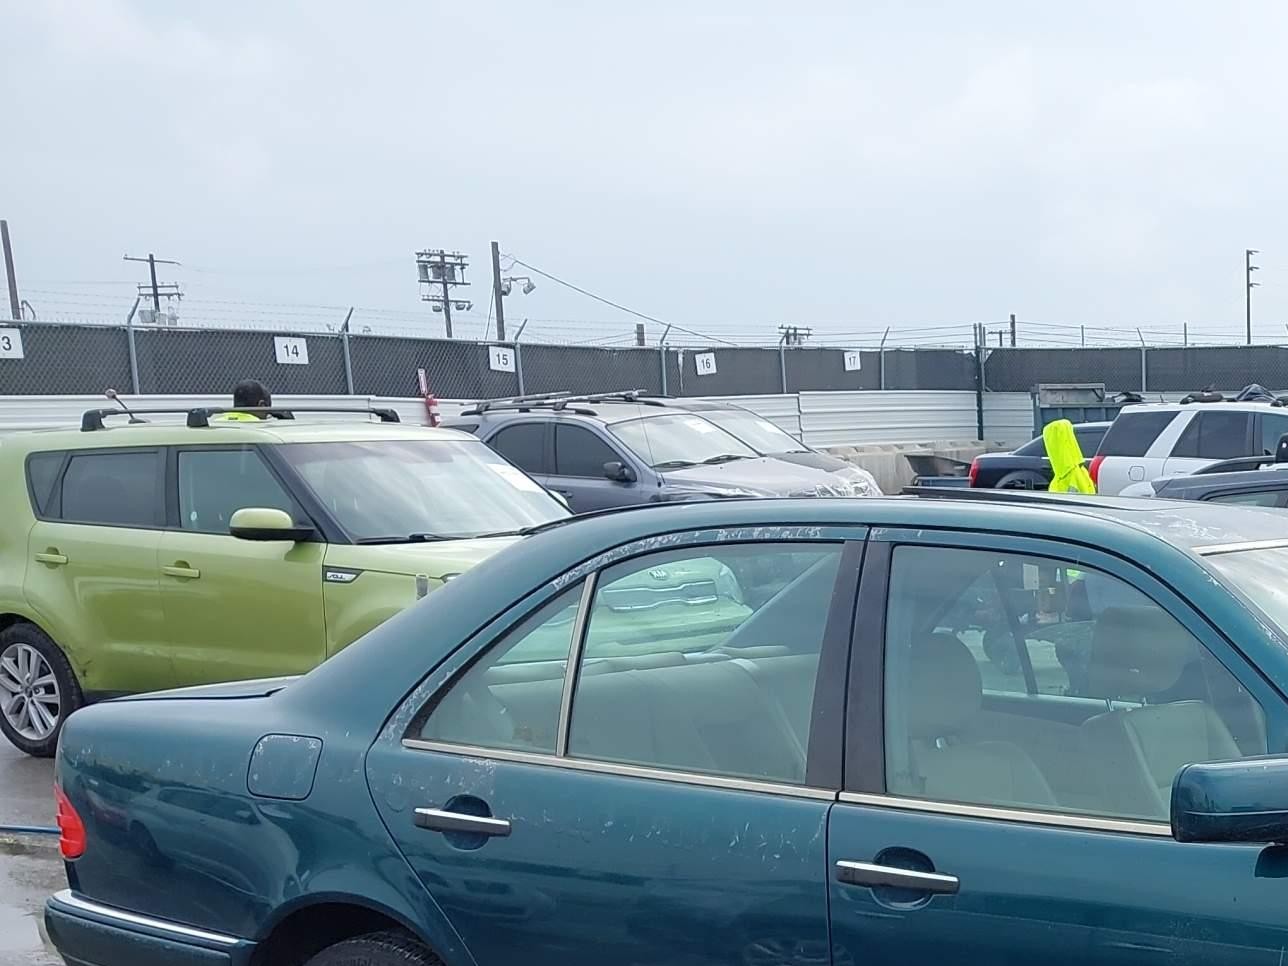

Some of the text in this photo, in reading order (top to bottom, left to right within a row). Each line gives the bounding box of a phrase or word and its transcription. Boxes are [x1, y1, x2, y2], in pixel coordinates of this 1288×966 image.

[283, 343, 299, 358] 14
[496, 352, 508, 366] 15
[701, 358, 711, 369] 16
[849, 355, 856, 367] 17
